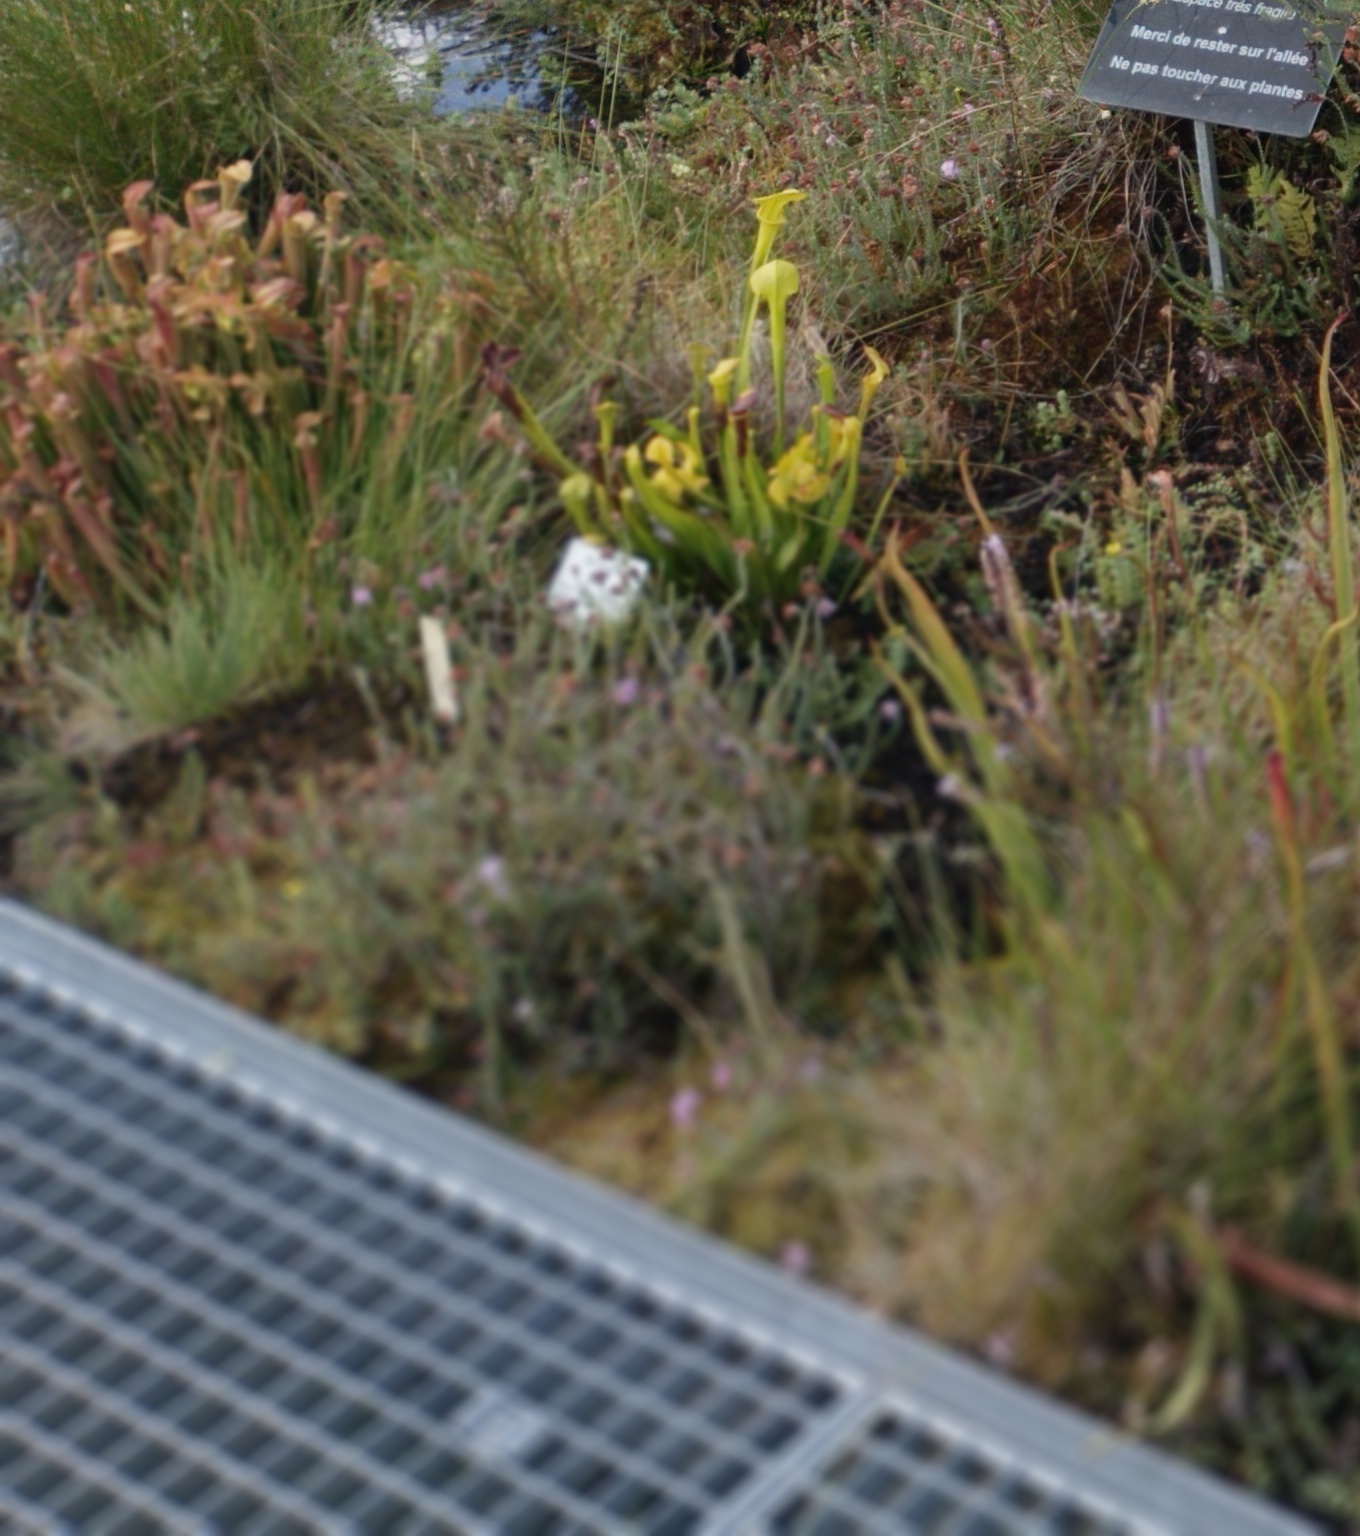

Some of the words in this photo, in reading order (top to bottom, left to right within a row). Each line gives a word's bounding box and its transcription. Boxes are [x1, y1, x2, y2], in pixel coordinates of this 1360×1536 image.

[1130, 24, 1170, 42] Merci
[1173, 31, 1191, 46] de
[1194, 38, 1237, 55] rester
[1239, 45, 1263, 58] sur
[1267, 47, 1308, 66] l'allée
[1110, 55, 1130, 70] Ne
[1132, 62, 1158, 76] pas
[1162, 66, 1218, 85] toucher
[1220, 76, 1246, 91] aux
